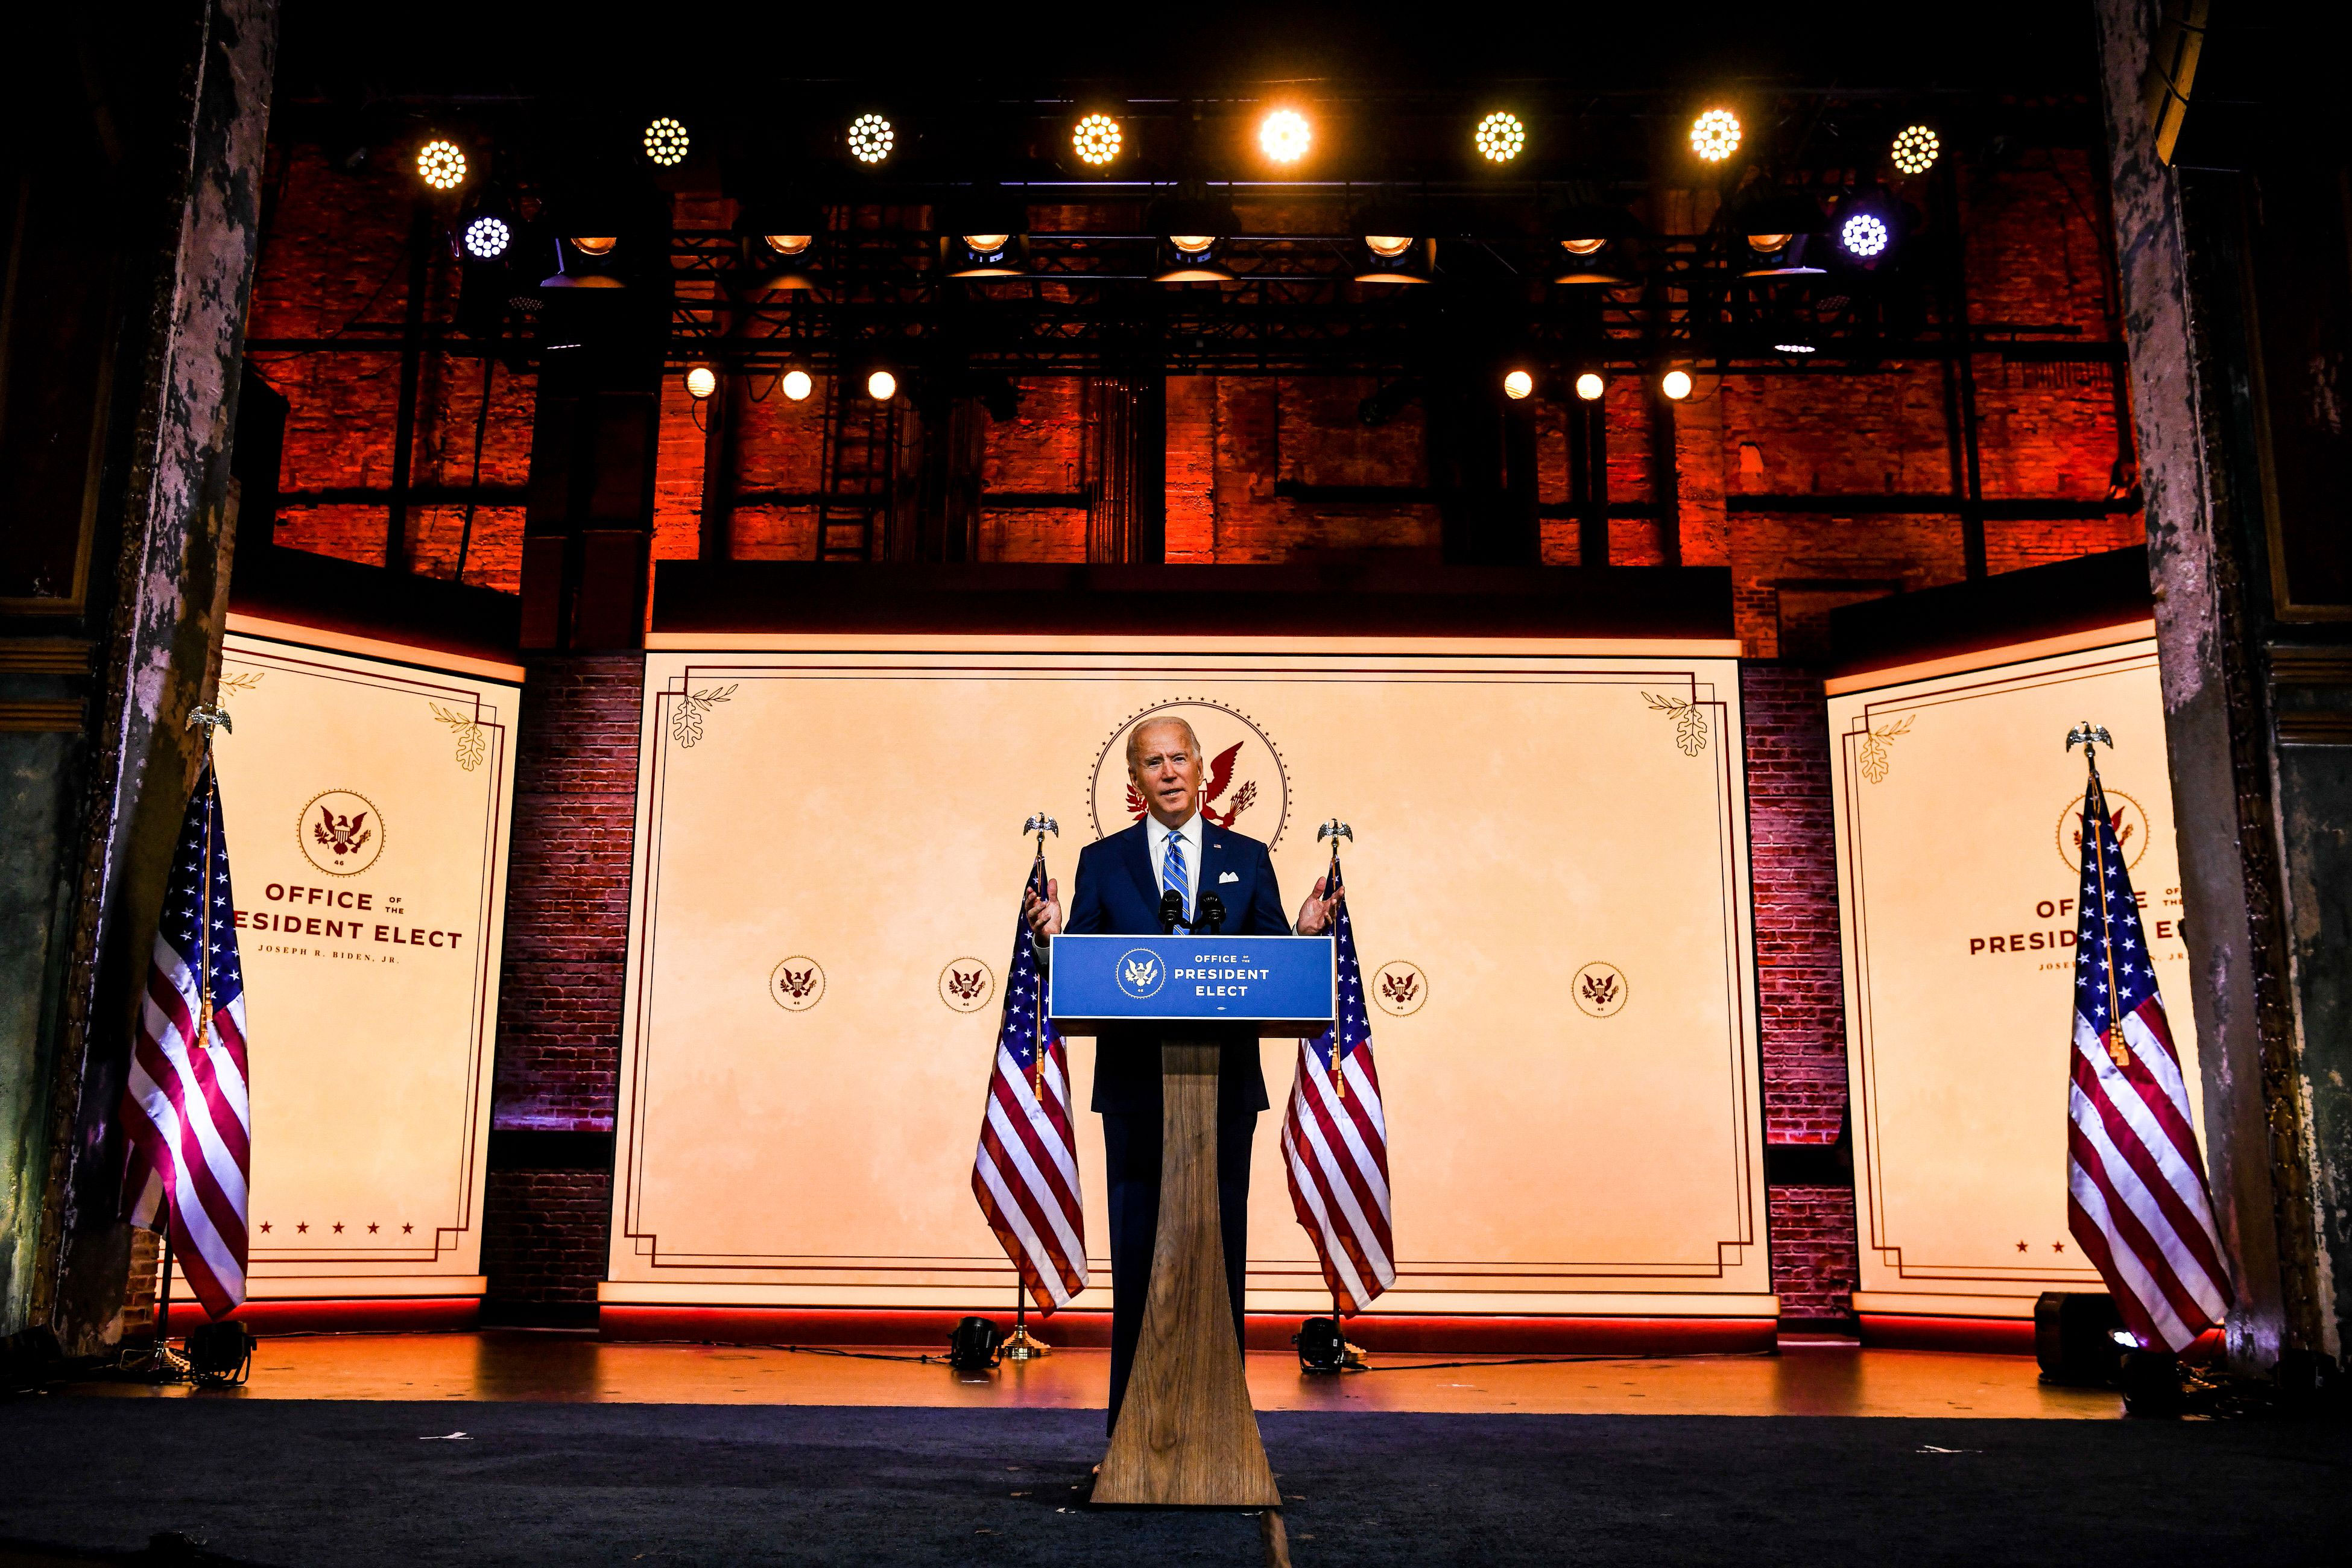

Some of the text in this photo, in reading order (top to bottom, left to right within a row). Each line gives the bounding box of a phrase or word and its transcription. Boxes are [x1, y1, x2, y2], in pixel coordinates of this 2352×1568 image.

[265, 883, 373, 911] OFFICE
[2036, 891, 2148, 918] OFE
[233, 911, 462, 949] ESIDENT ELECT
[1970, 929, 2078, 955] PRESID
[258, 944, 307, 956] JOSEPH
[333, 951, 375, 963] BIDEN,
[382, 956, 399, 964] JR.
[1195, 955, 1237, 963] OFFICE
[1174, 969, 1269, 980] PRESIDENT
[2039, 961, 2076, 971] JOSE
[1195, 985, 1248, 996] ELECT
